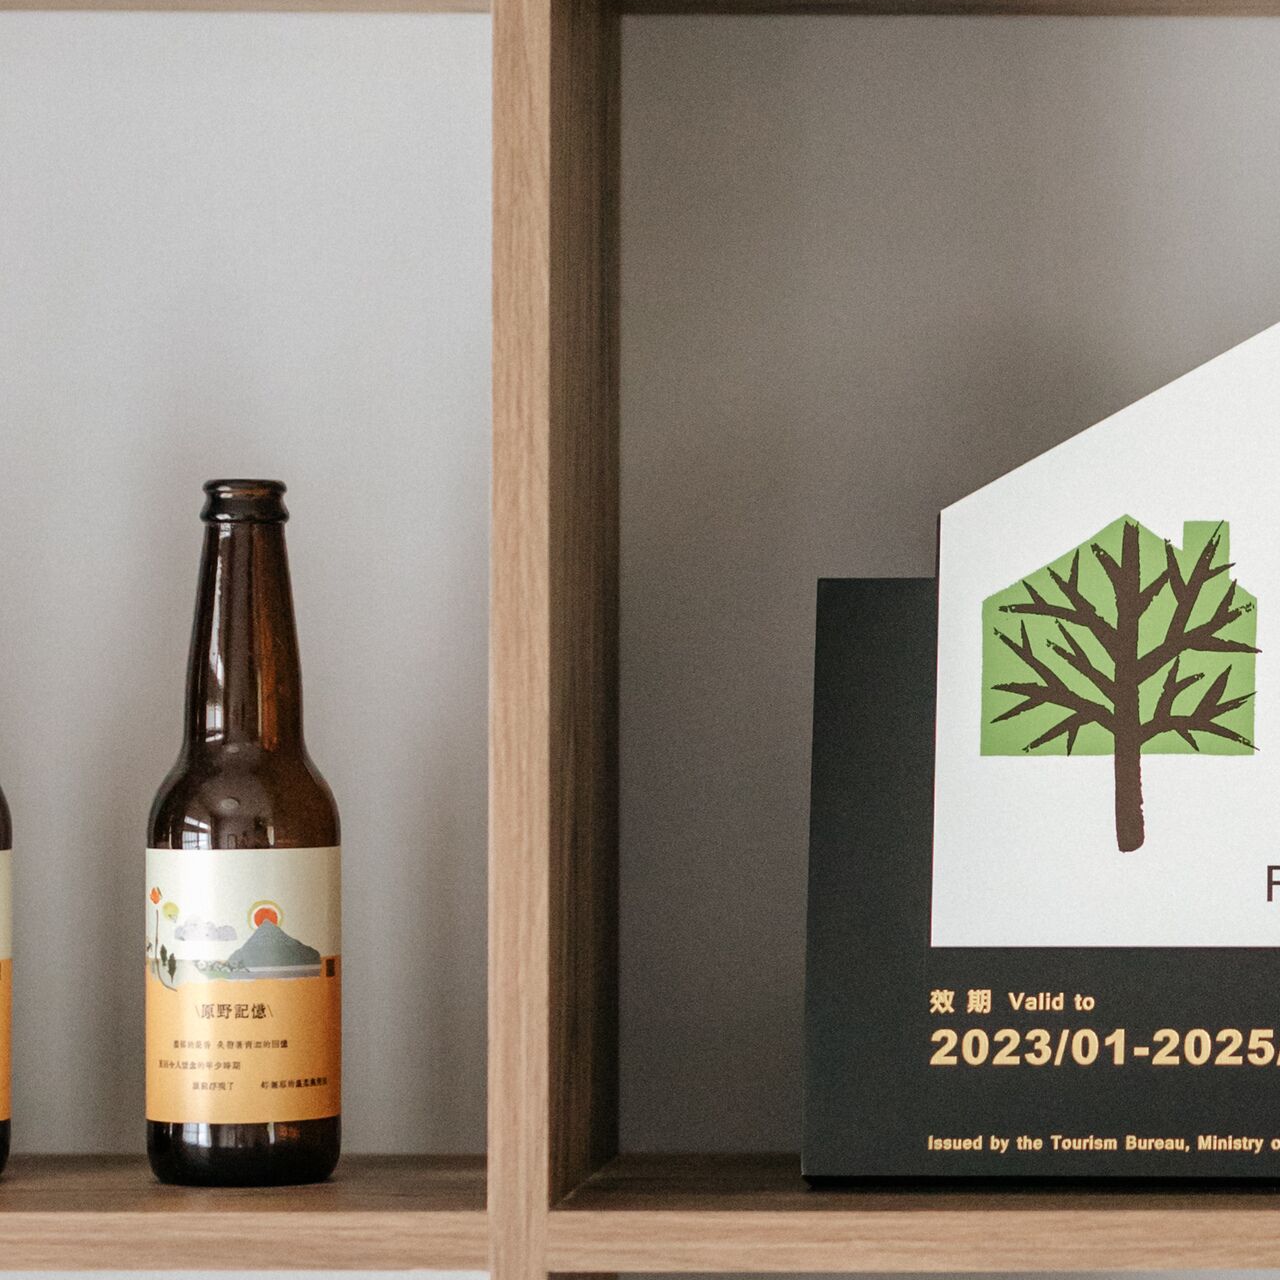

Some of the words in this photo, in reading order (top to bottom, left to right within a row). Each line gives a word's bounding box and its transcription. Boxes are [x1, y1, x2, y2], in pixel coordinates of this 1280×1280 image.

[1008, 991, 1065, 1012] Valid
[1073, 993, 1096, 1012] to
[928, 1135, 982, 1150] Issued
[990, 1135, 1009, 1155] by
[1016, 1135, 1043, 1150] the
[1050, 1135, 1117, 1150] Tourism
[1125, 1135, 1190, 1153] Bureau,
[1198, 1135, 1264, 1155] Ministry
